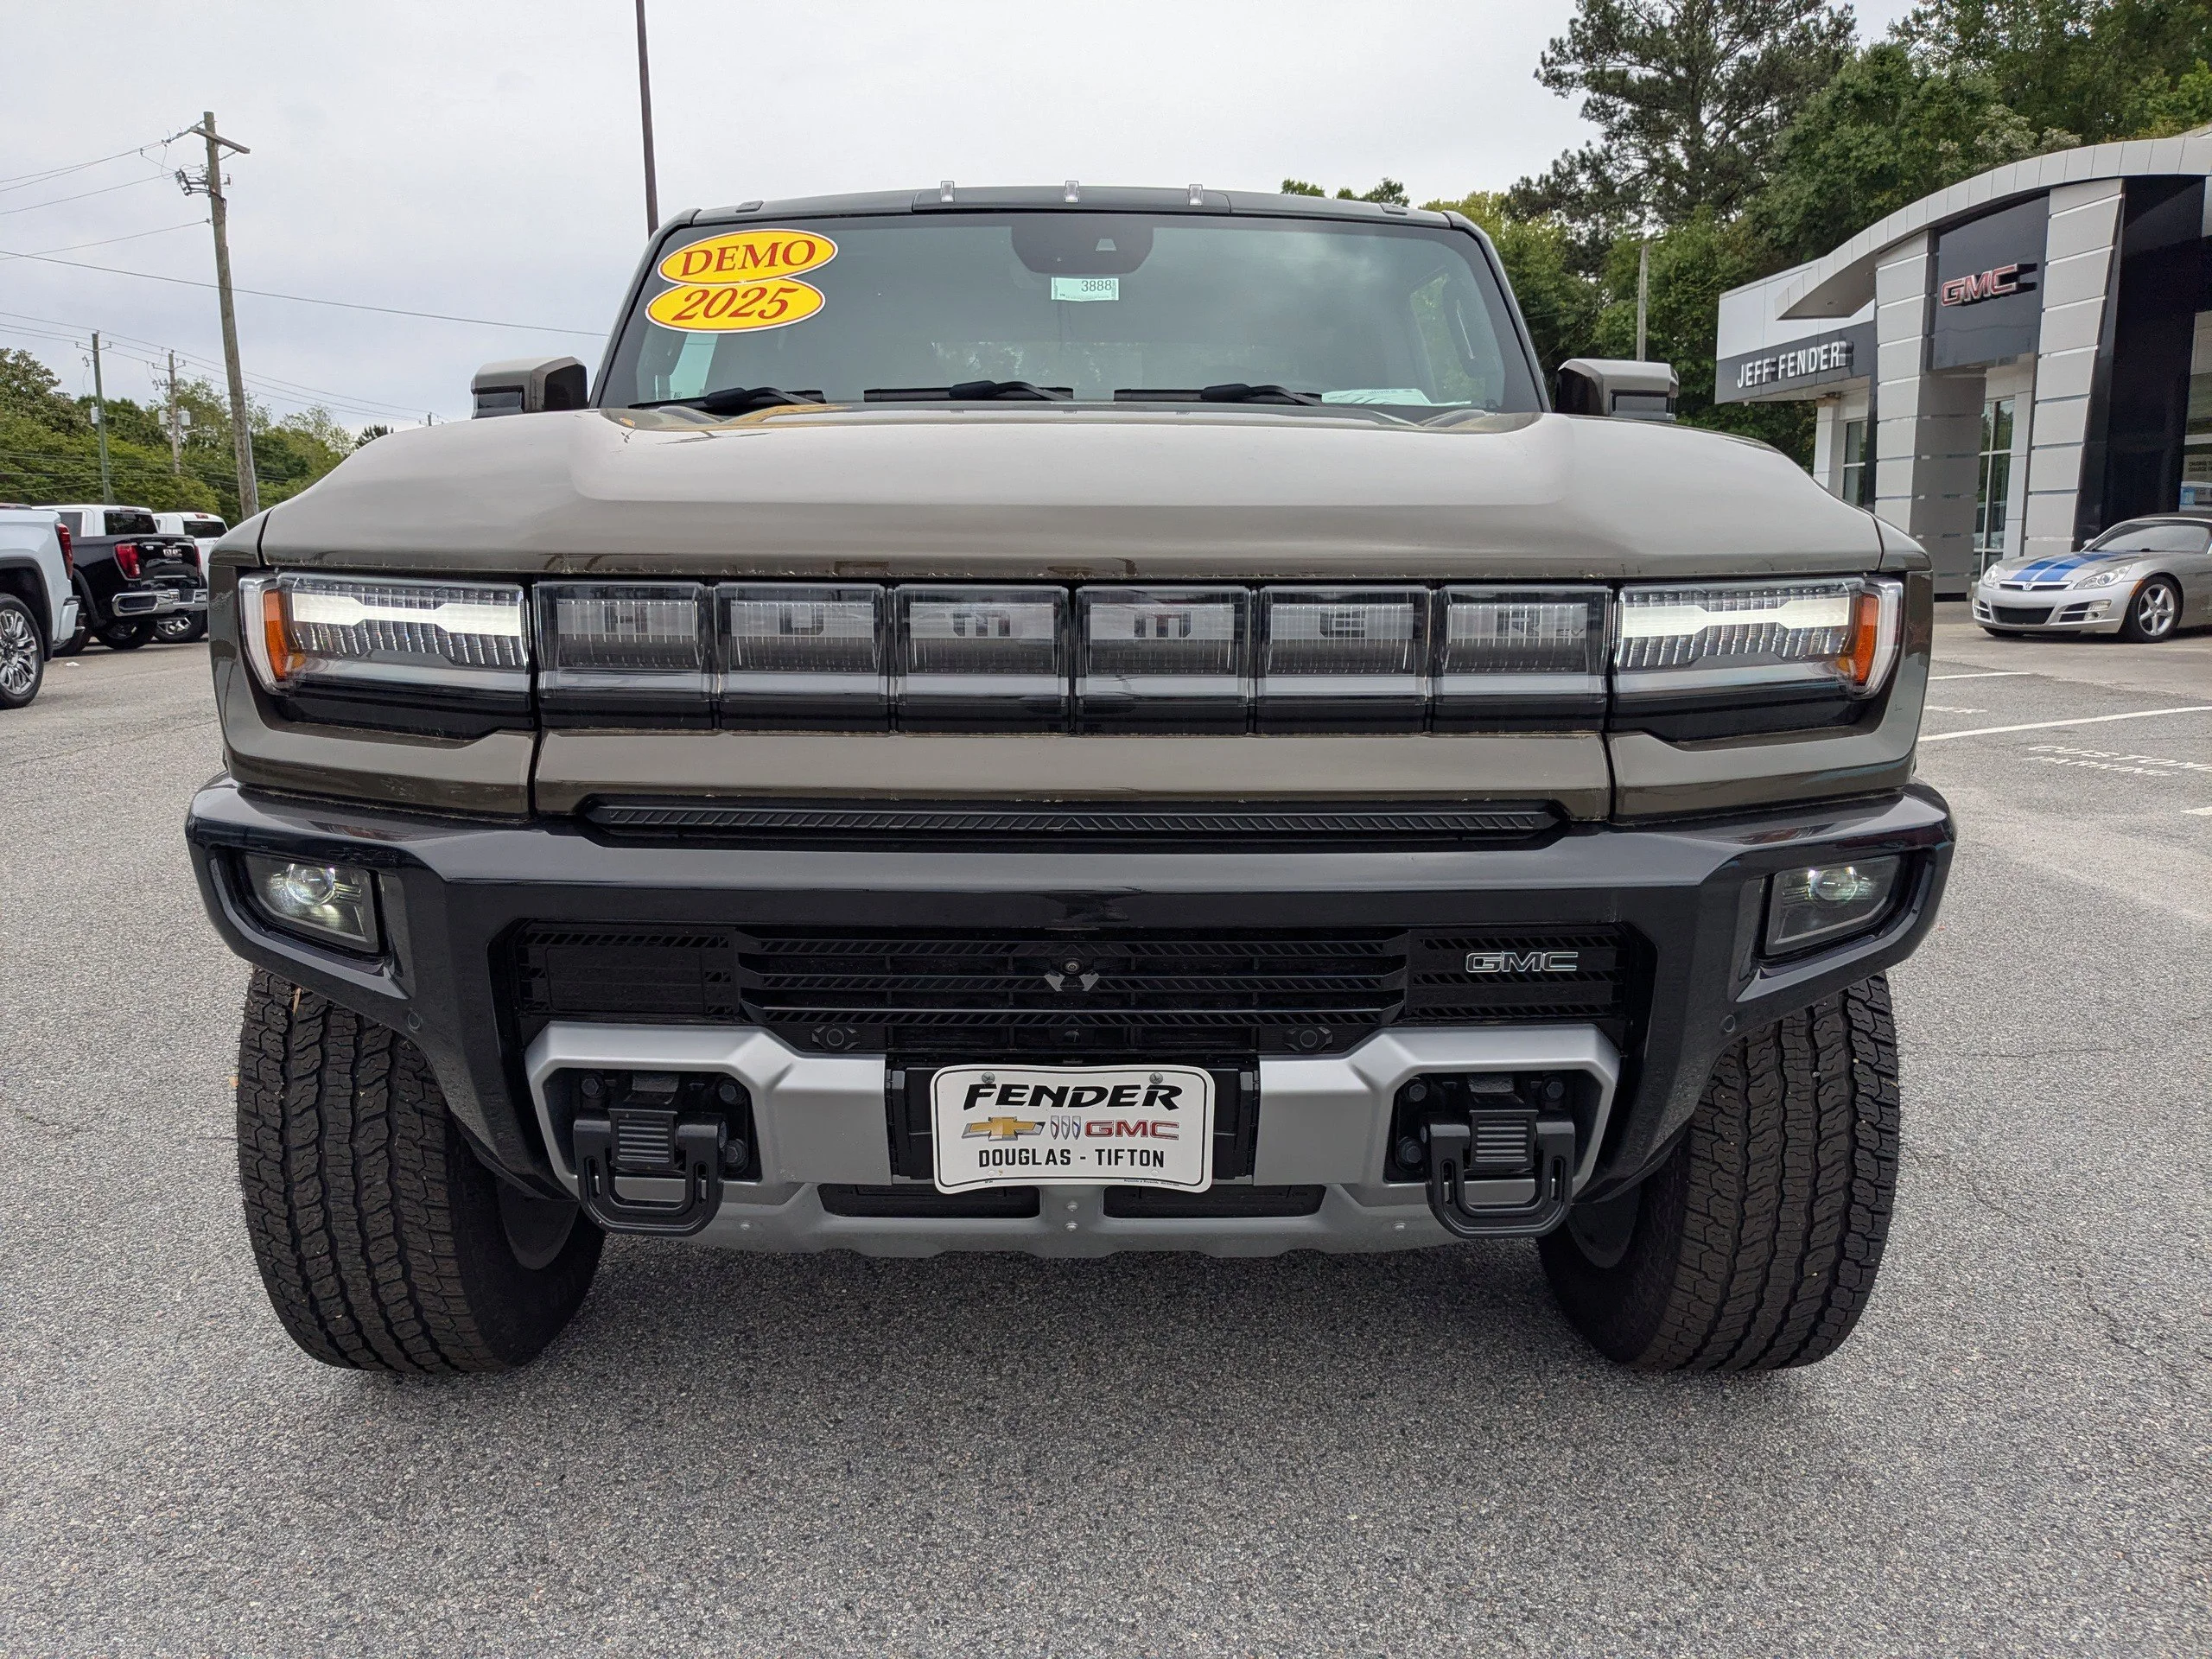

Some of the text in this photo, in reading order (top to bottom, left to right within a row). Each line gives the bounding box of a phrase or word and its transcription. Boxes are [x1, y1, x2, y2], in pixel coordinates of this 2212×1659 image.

[680, 240, 816, 276] DEMO
[1081, 279, 1112, 292] 3888
[1941, 263, 2018, 307] GMC
[671, 287, 799, 321] 2025
[1737, 340, 1847, 388] JEFF FENDER
[1466, 951, 1578, 972] GMC
[963, 1084, 1183, 1111] FENDER
[1084, 1119, 1179, 1141] GMC
[979, 1148, 1071, 1167] DOUGLAS
[1095, 1148, 1165, 1168] TIFTON
